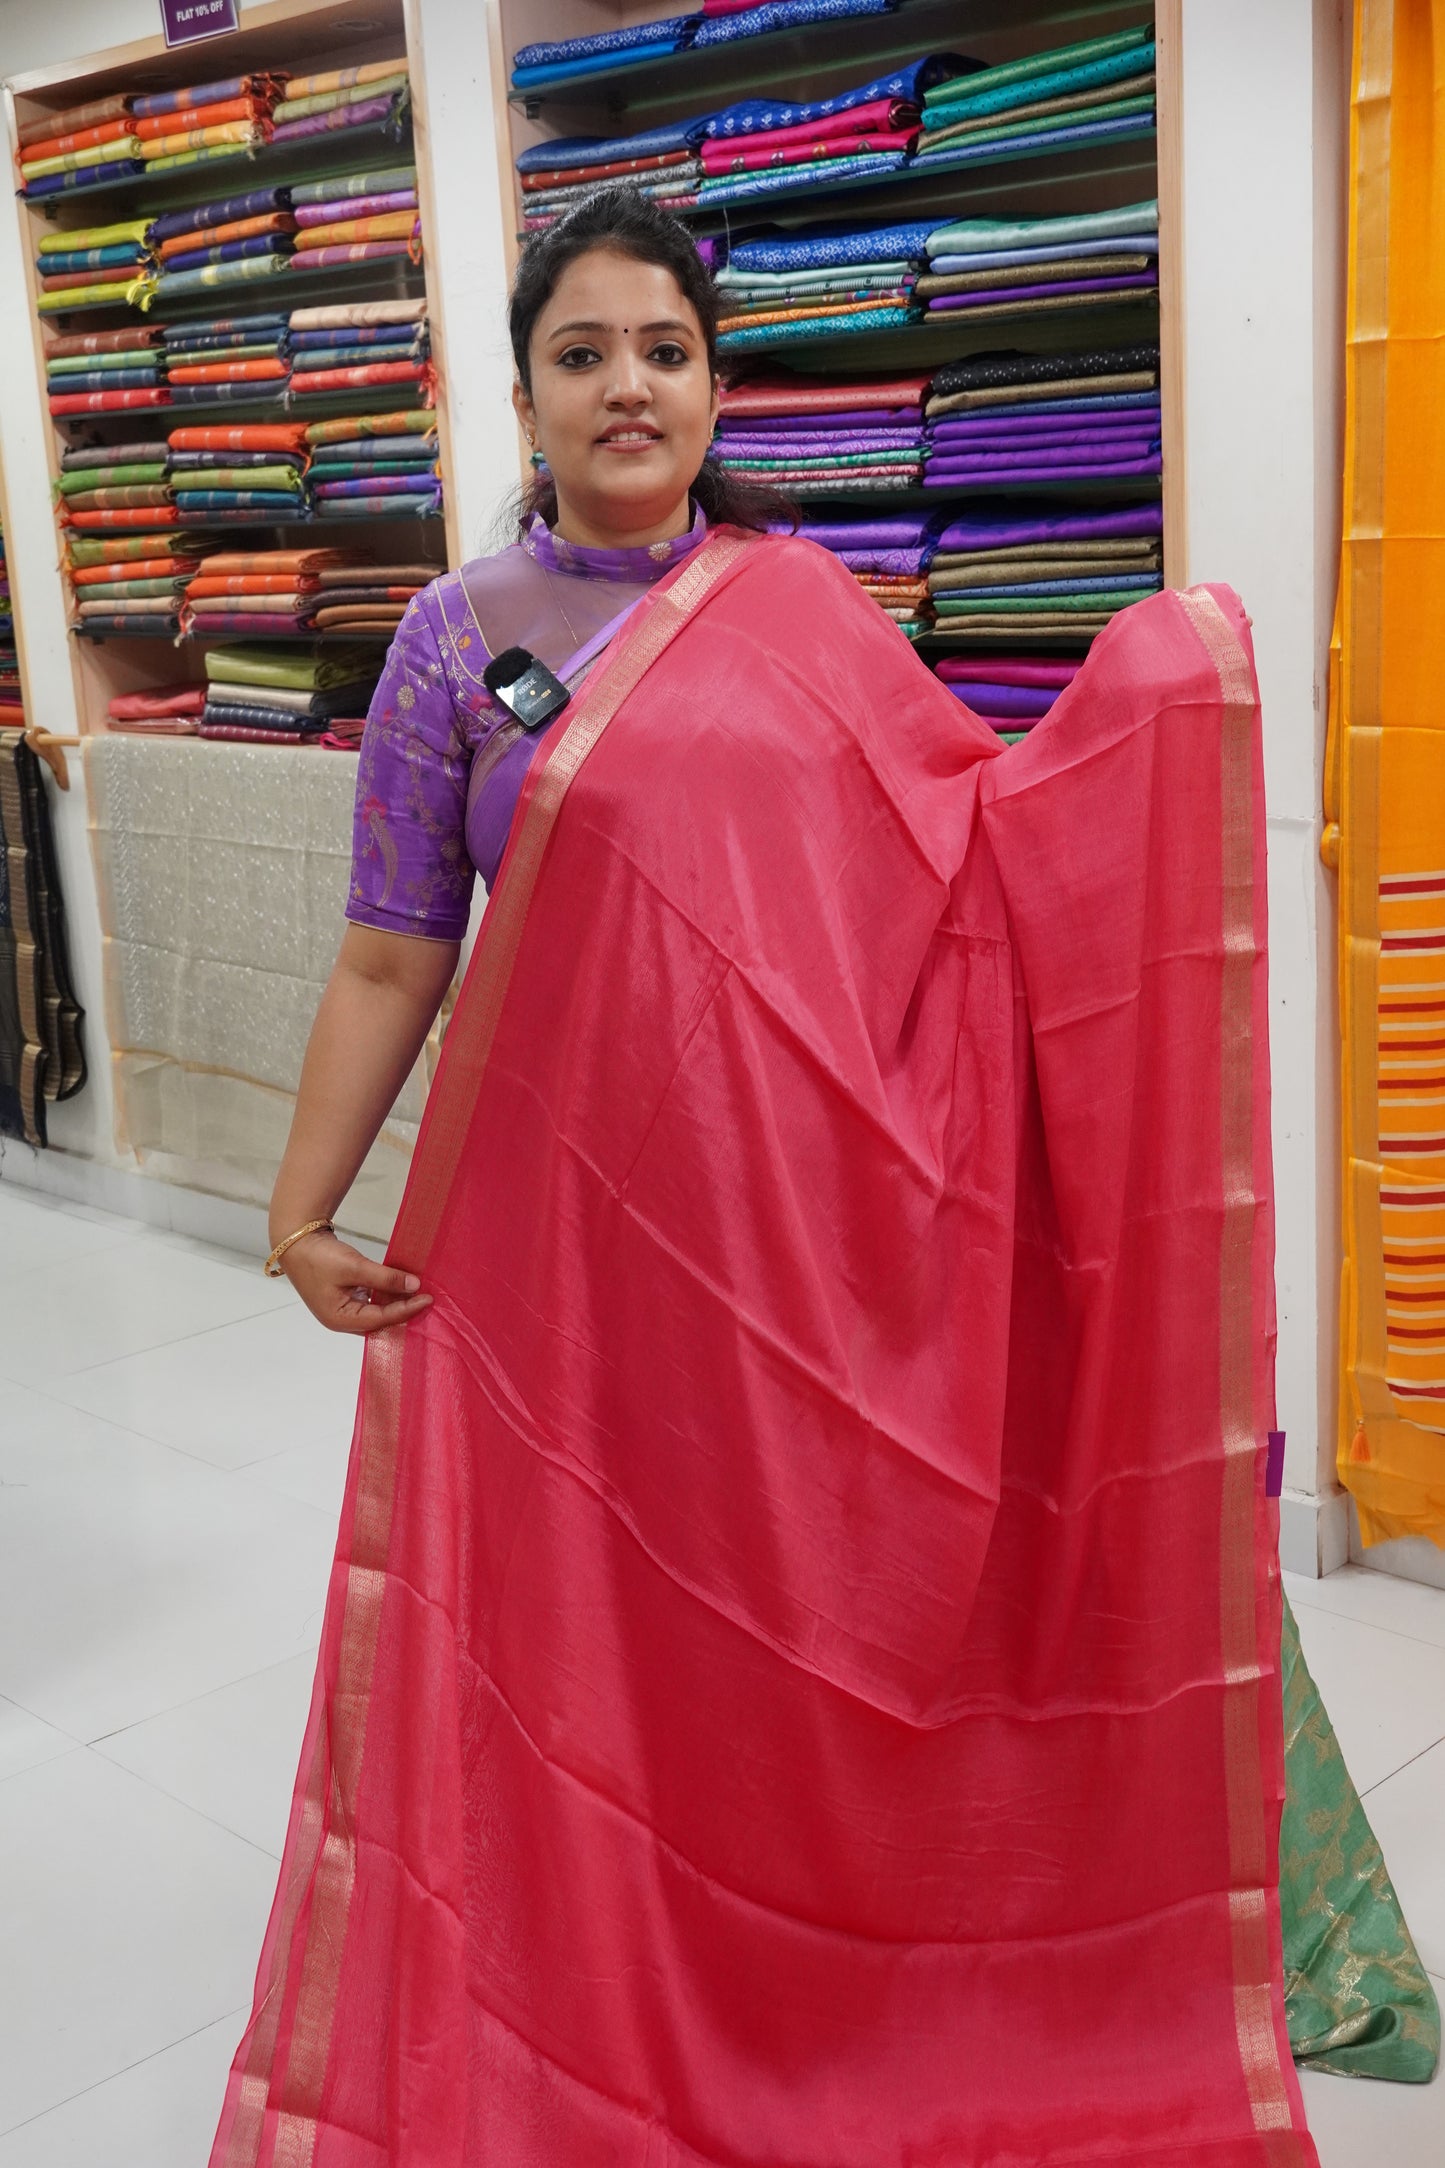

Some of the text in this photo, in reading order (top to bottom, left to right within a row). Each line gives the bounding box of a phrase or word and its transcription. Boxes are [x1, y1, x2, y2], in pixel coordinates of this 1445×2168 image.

[176, 0, 224, 22] FLAT 10% OFF
